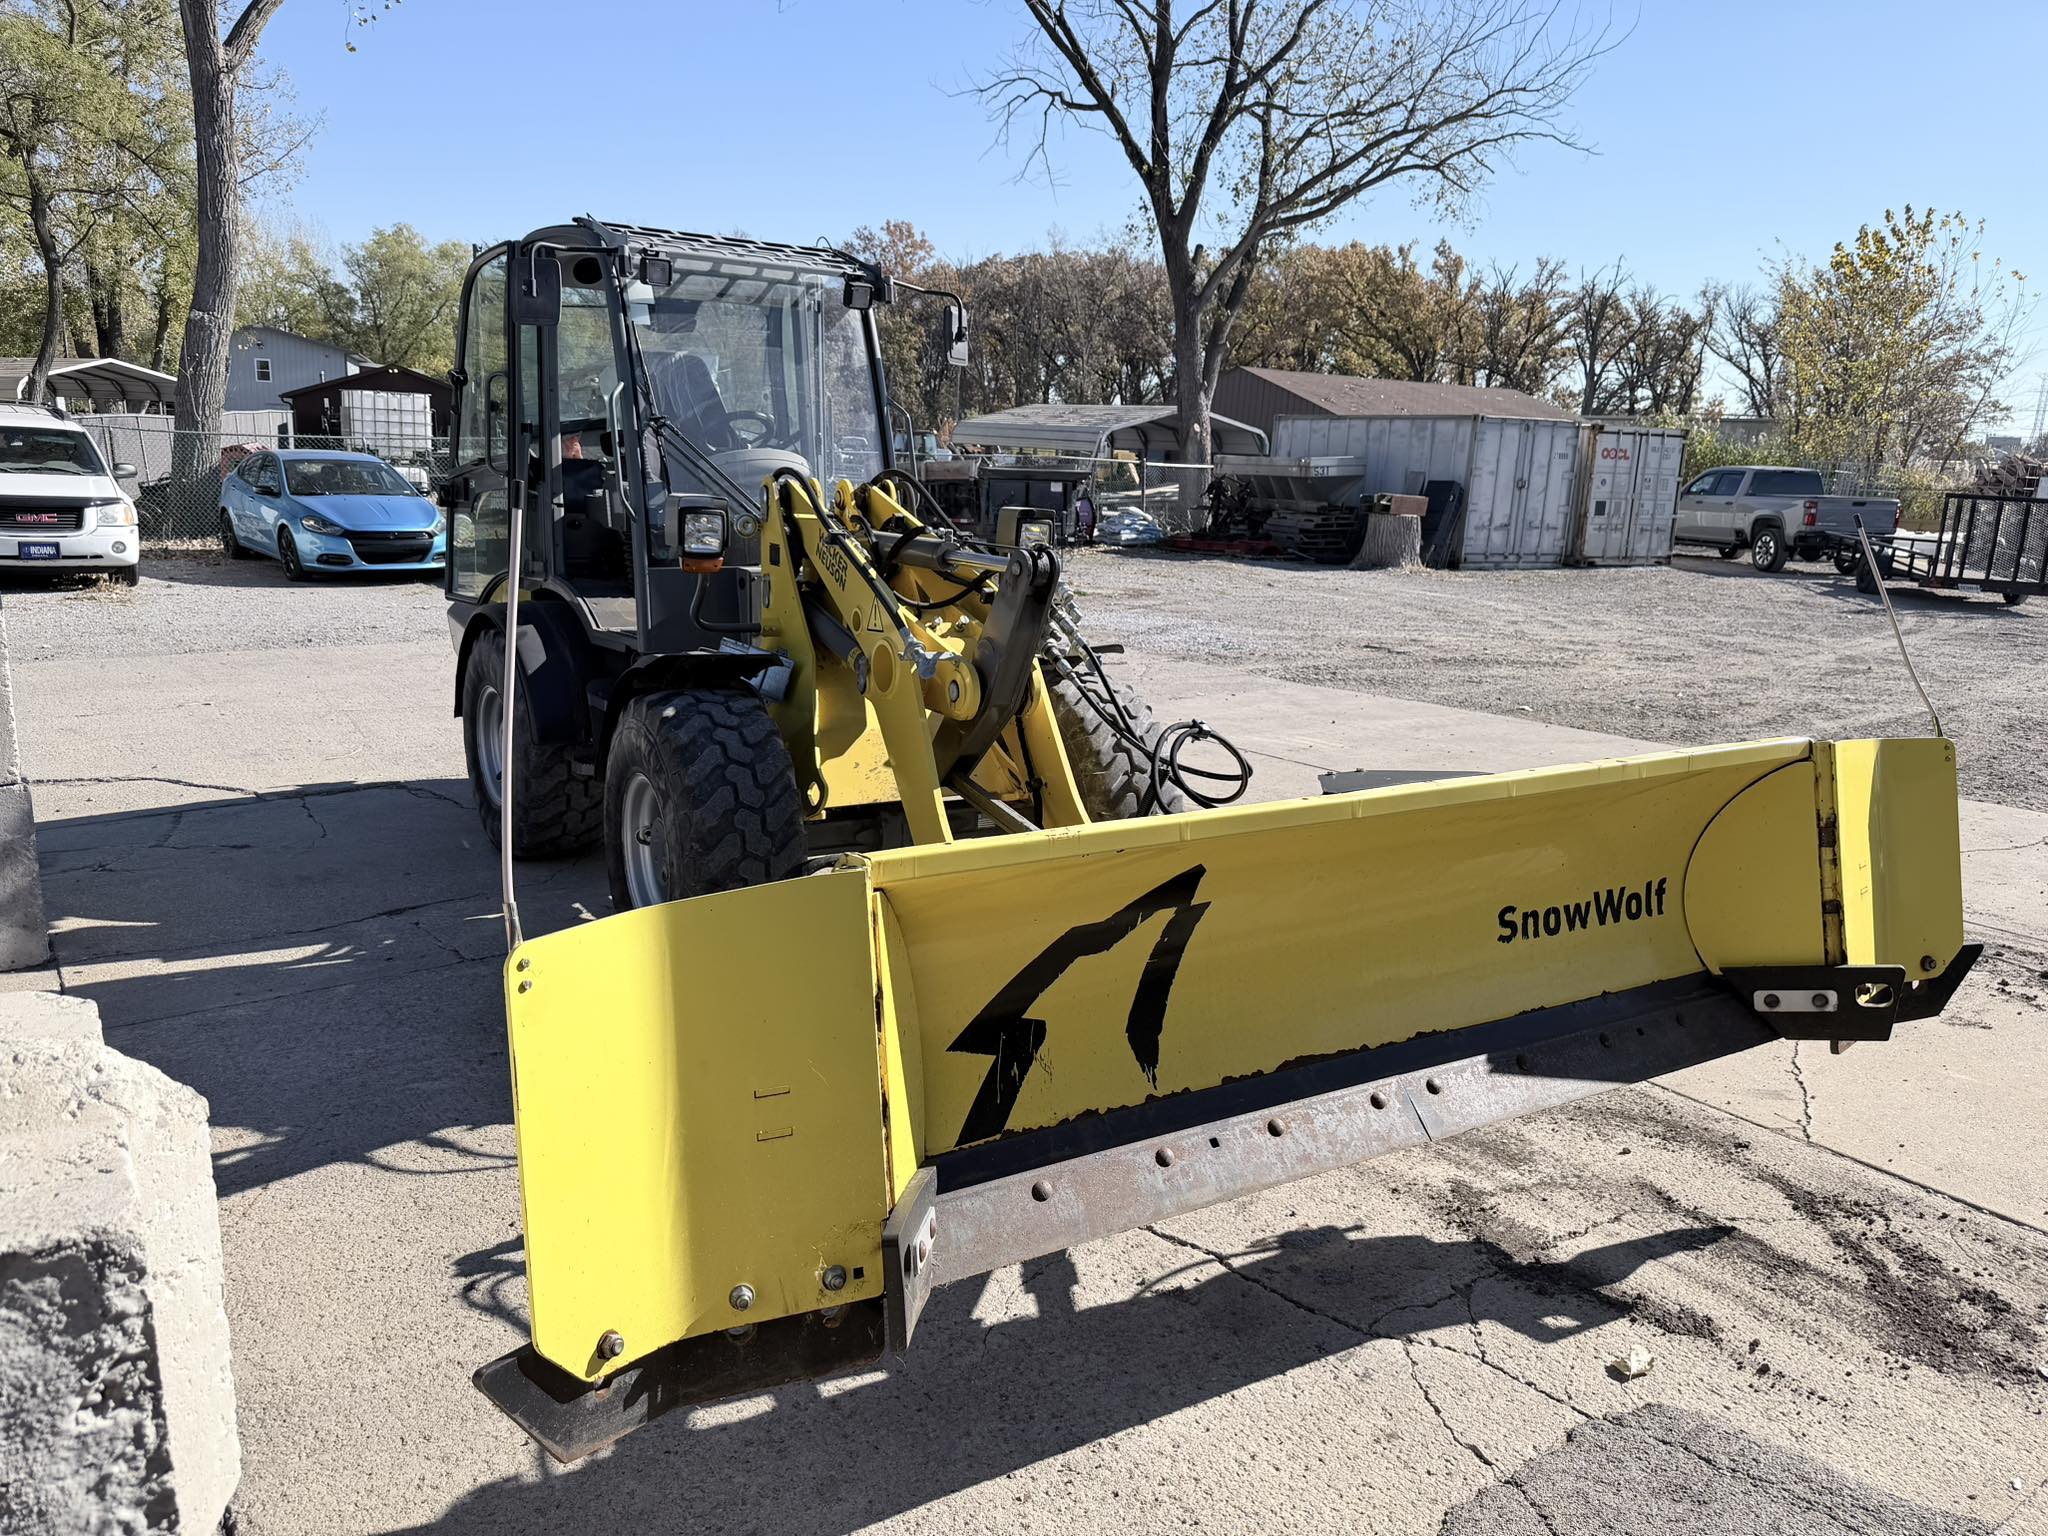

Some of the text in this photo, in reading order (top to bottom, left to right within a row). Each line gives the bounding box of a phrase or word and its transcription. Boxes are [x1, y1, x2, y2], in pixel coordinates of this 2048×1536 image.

[15, 513, 58, 524] GMC
[30, 545, 57, 555] INDIANA
[816, 542, 847, 593] NEUSON
[818, 527, 848, 577] WCKER
[1497, 876, 1667, 944] SnowWolf
